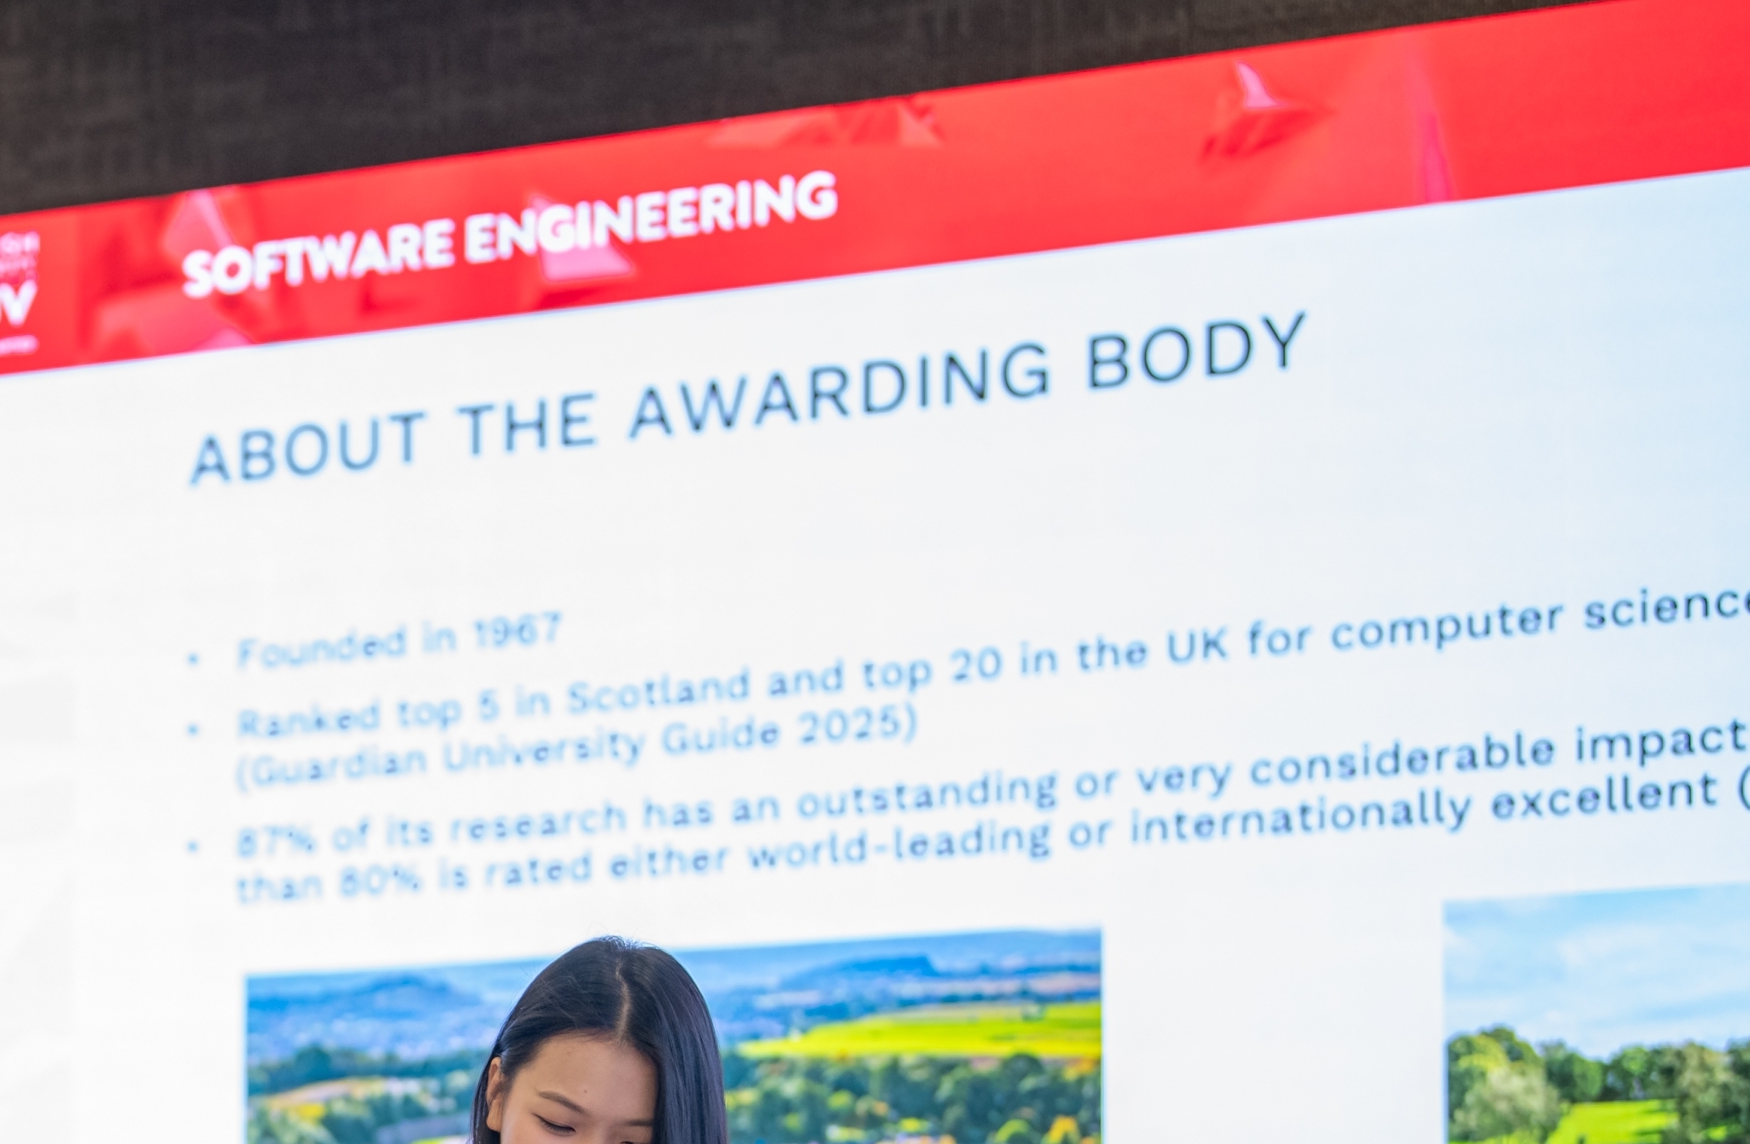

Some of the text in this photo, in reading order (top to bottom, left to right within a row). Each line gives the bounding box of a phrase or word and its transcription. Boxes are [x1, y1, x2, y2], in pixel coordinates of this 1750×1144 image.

[183, 170, 838, 298] SOFTWARE ENGINEERING
[189, 311, 1306, 486] ABOUT THE AWARDING BODY
[238, 611, 562, 669] Founded in 1967
[238, 588, 1750, 739] Ranked top 5 in Scotland and top 20 in the UK for computer scienc
[236, 702, 917, 792] (Guardian University Guide 2025)
[332, 816, 371, 853] of
[387, 816, 434, 847] its
[451, 802, 626, 842] research
[643, 796, 714, 828] has
[731, 797, 780, 824] an
[797, 772, 1058, 819] outstanding
[1074, 770, 1119, 800] or
[1137, 763, 1232, 799] very
[1250, 731, 1555, 786] considerable
[1577, 719, 1747, 767] impact
[236, 869, 322, 904] than
[440, 865, 469, 891] is
[486, 851, 592, 887] rated
[609, 846, 728, 880] either
[748, 820, 1052, 869] world-leading
[1068, 820, 1112, 850] or
[1132, 787, 1472, 842] internationally
[1491, 773, 1717, 820] excellent
